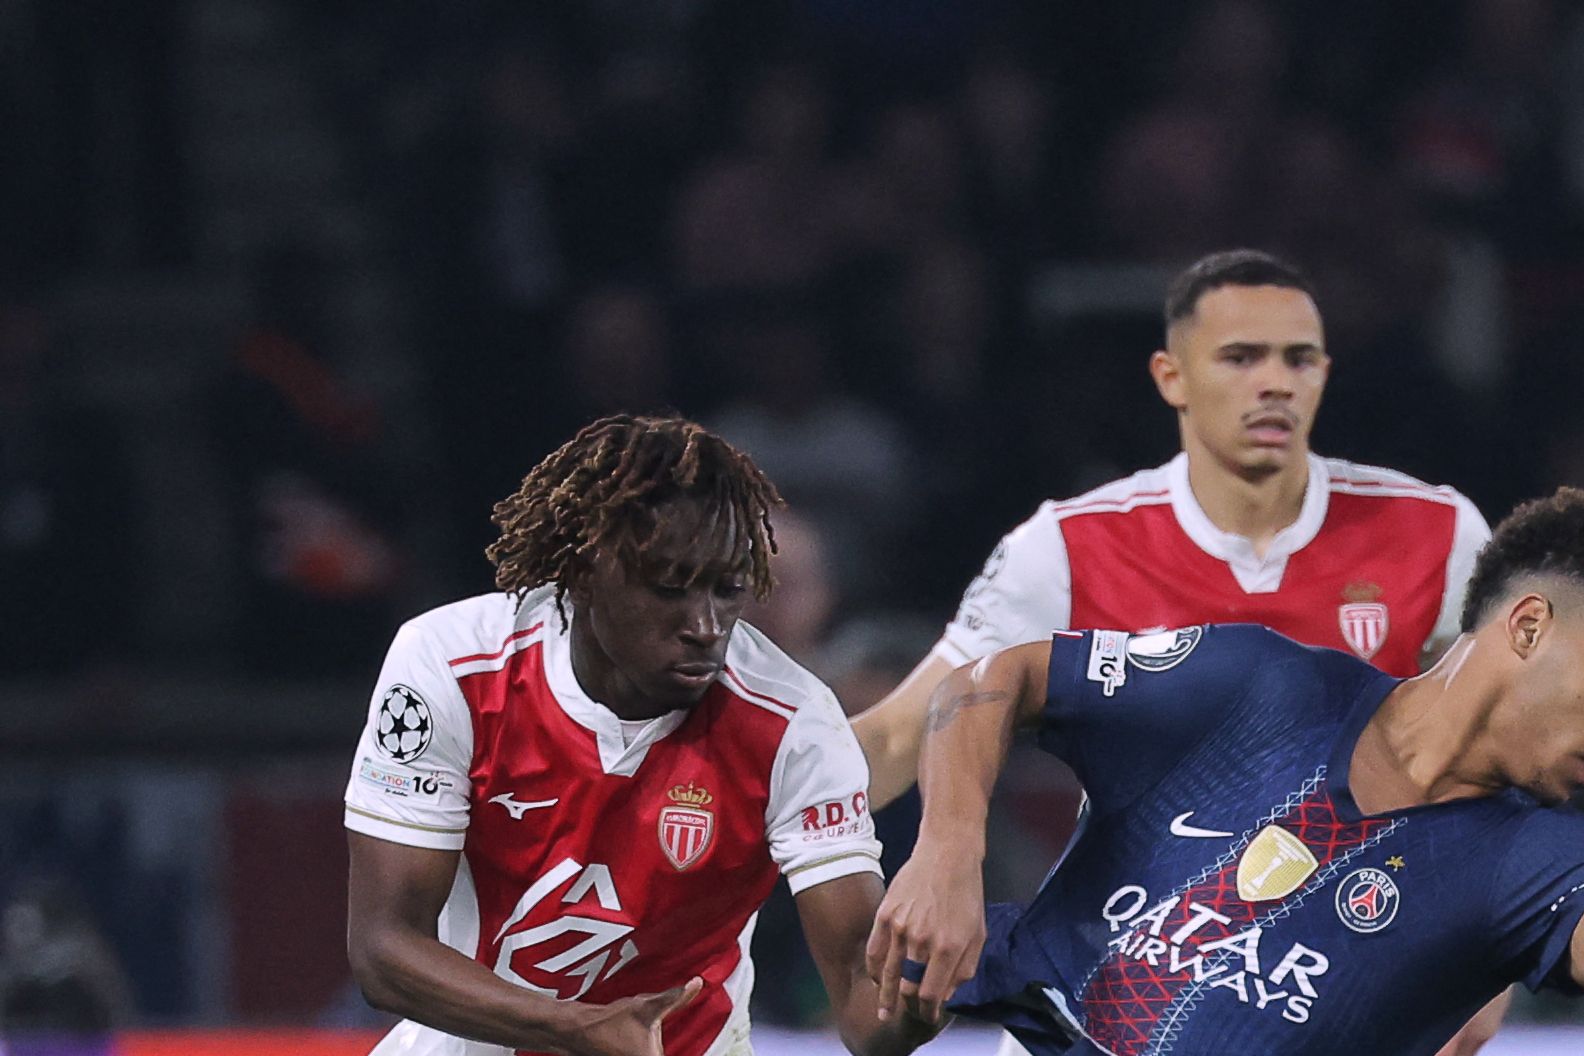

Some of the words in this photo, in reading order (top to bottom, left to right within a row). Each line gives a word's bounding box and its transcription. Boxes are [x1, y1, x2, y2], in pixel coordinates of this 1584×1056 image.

[801, 801, 849, 832] R.D.
[1359, 871, 1395, 898] PARIS
[1102, 885, 1329, 999] QATAR
[1107, 930, 1313, 1025] AIRWAYS
